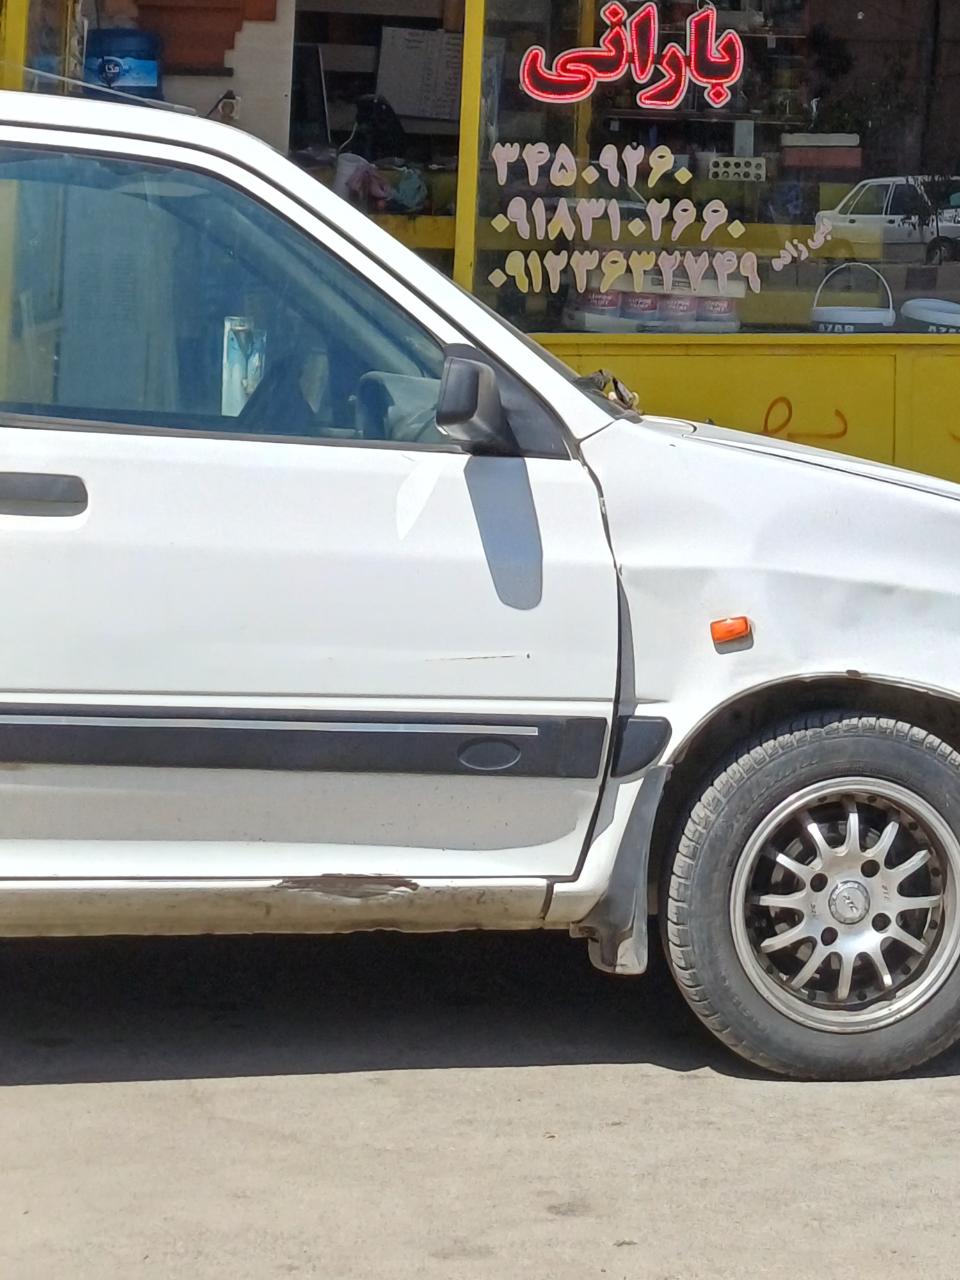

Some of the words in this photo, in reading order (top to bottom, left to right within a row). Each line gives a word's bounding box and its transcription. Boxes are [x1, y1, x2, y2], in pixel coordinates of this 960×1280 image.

[519, 1, 743, 109] بارانی
[491, 142, 693, 188] ۳۴۵۰۹۲۶۰
[490, 196, 746, 241] ۰۹۱۸۳۱۰۲۶۶۰
[488, 249, 761, 294] ۰۹۱۲۳۶۳۲۷۴۹
